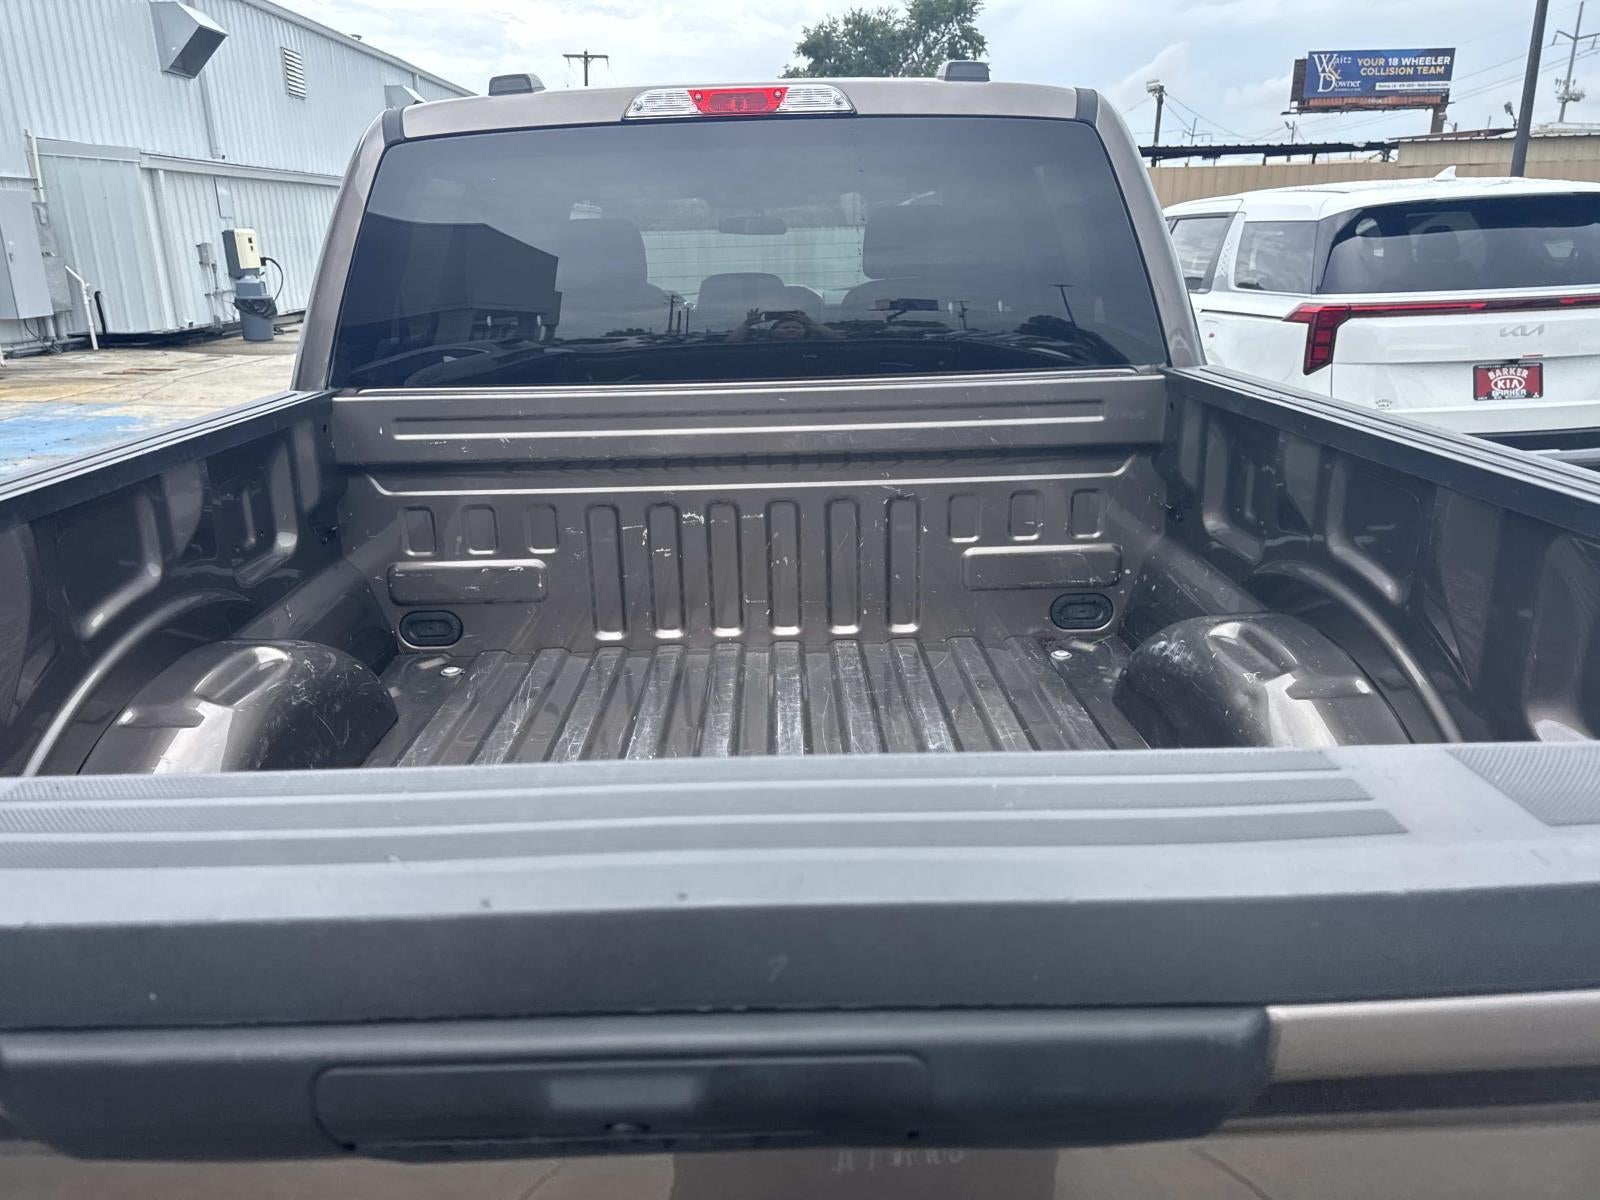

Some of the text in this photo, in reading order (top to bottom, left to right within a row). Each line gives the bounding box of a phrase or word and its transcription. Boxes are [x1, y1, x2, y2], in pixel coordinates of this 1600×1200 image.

[1357, 56, 1451, 67] YOUR 18 WHEELER
[1360, 66, 1444, 76] COLLISION TEAM
[1317, 73, 1361, 92] Downer
[1488, 367, 1529, 380] BARKER
[1497, 379, 1520, 389] KIA
